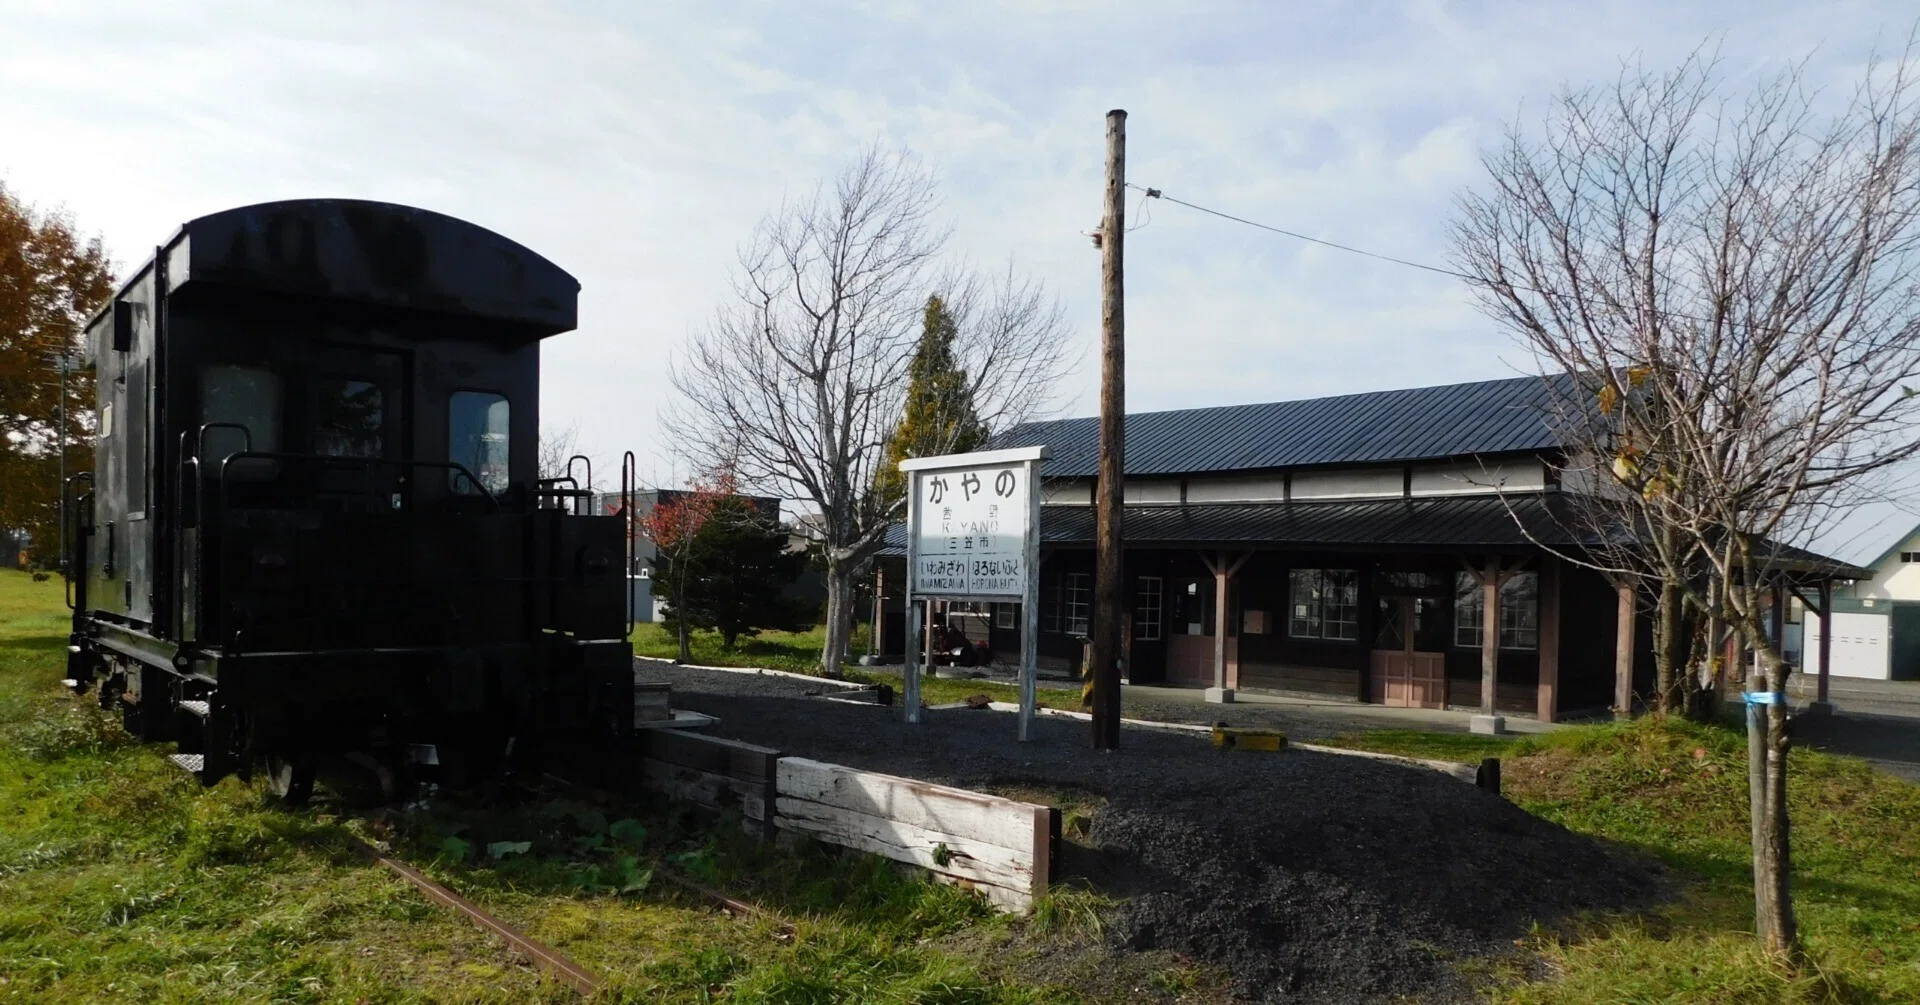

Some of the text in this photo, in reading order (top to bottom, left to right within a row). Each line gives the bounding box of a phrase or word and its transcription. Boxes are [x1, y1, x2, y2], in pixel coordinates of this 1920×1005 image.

[929, 469, 1016, 504] かやの
[942, 520, 999, 534] KYANO
[920, 559, 965, 576] いわみざわ
[972, 558, 1019, 576] ほろないぶと
